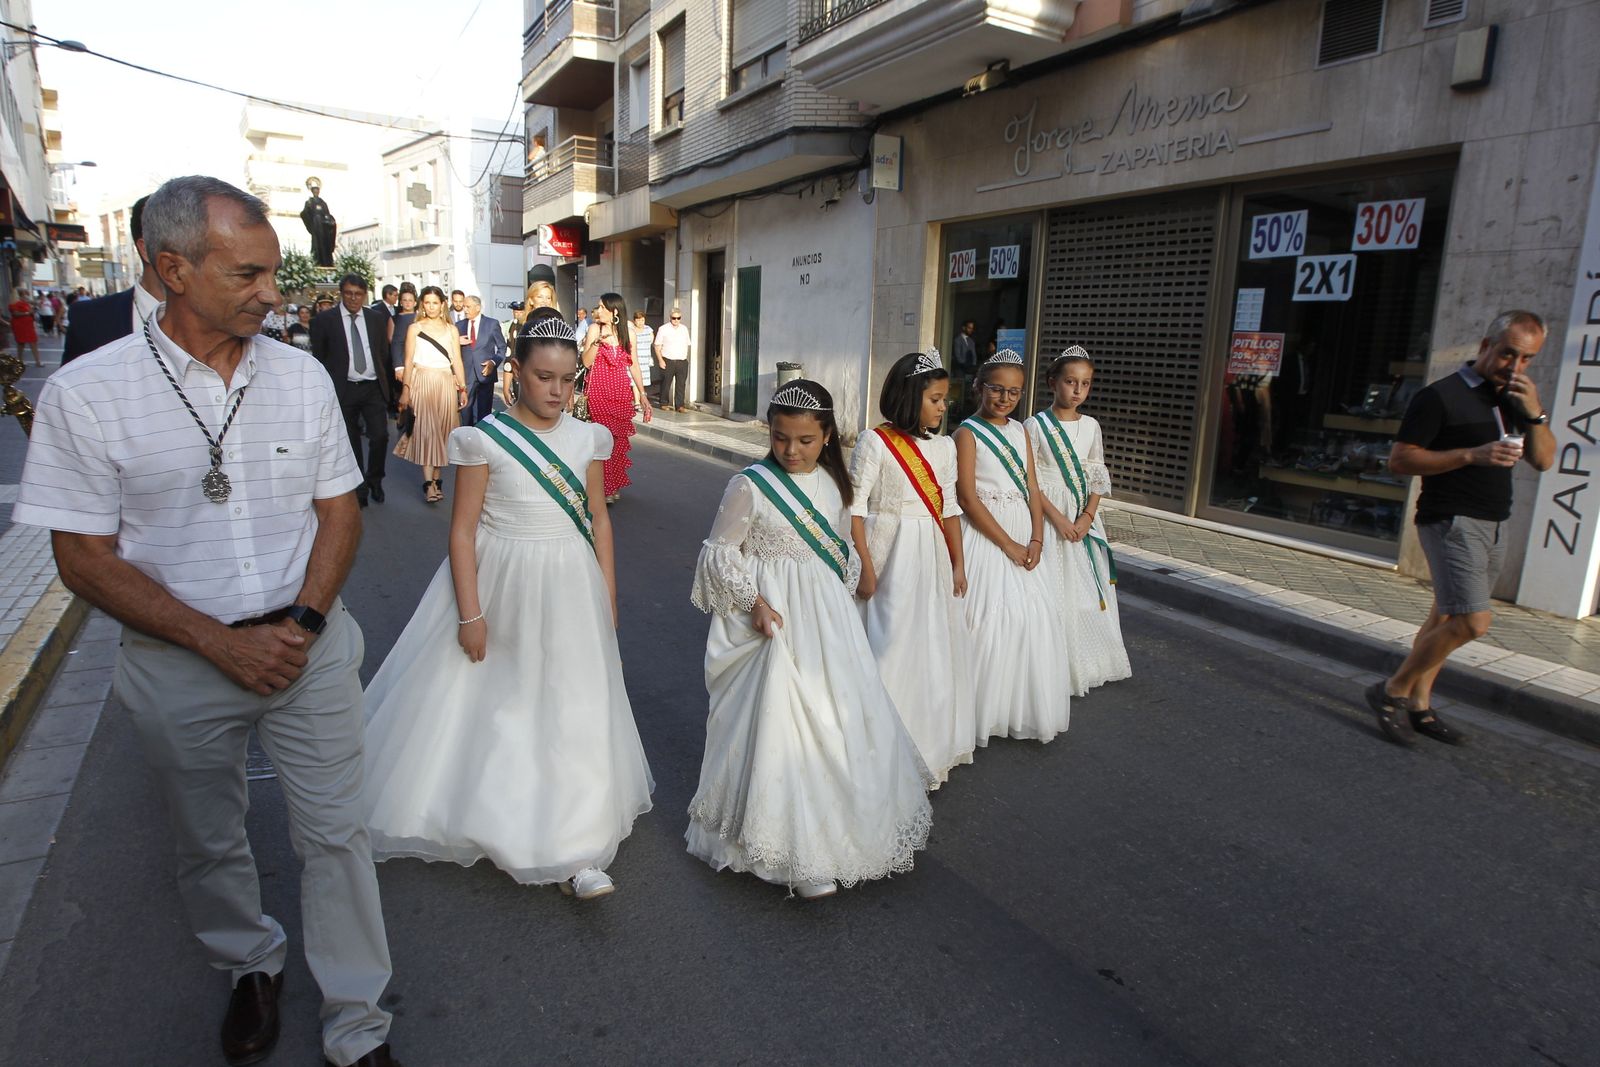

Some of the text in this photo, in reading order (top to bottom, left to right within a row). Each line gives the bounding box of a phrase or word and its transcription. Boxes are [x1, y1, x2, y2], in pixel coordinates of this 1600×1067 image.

[1004, 97, 1103, 176] Jorge
[1100, 128, 1234, 175] ZAPATERIA
[1253, 212, 1303, 253] 50%
[1357, 201, 1417, 245] 30%
[792, 253, 822, 267] ANUNCIOS
[950, 251, 974, 278] 20%
[990, 247, 1017, 275] 50%
[799, 273, 810, 285] NO
[1297, 260, 1352, 294] 2X1
[1234, 338, 1280, 349] PITILLOS
